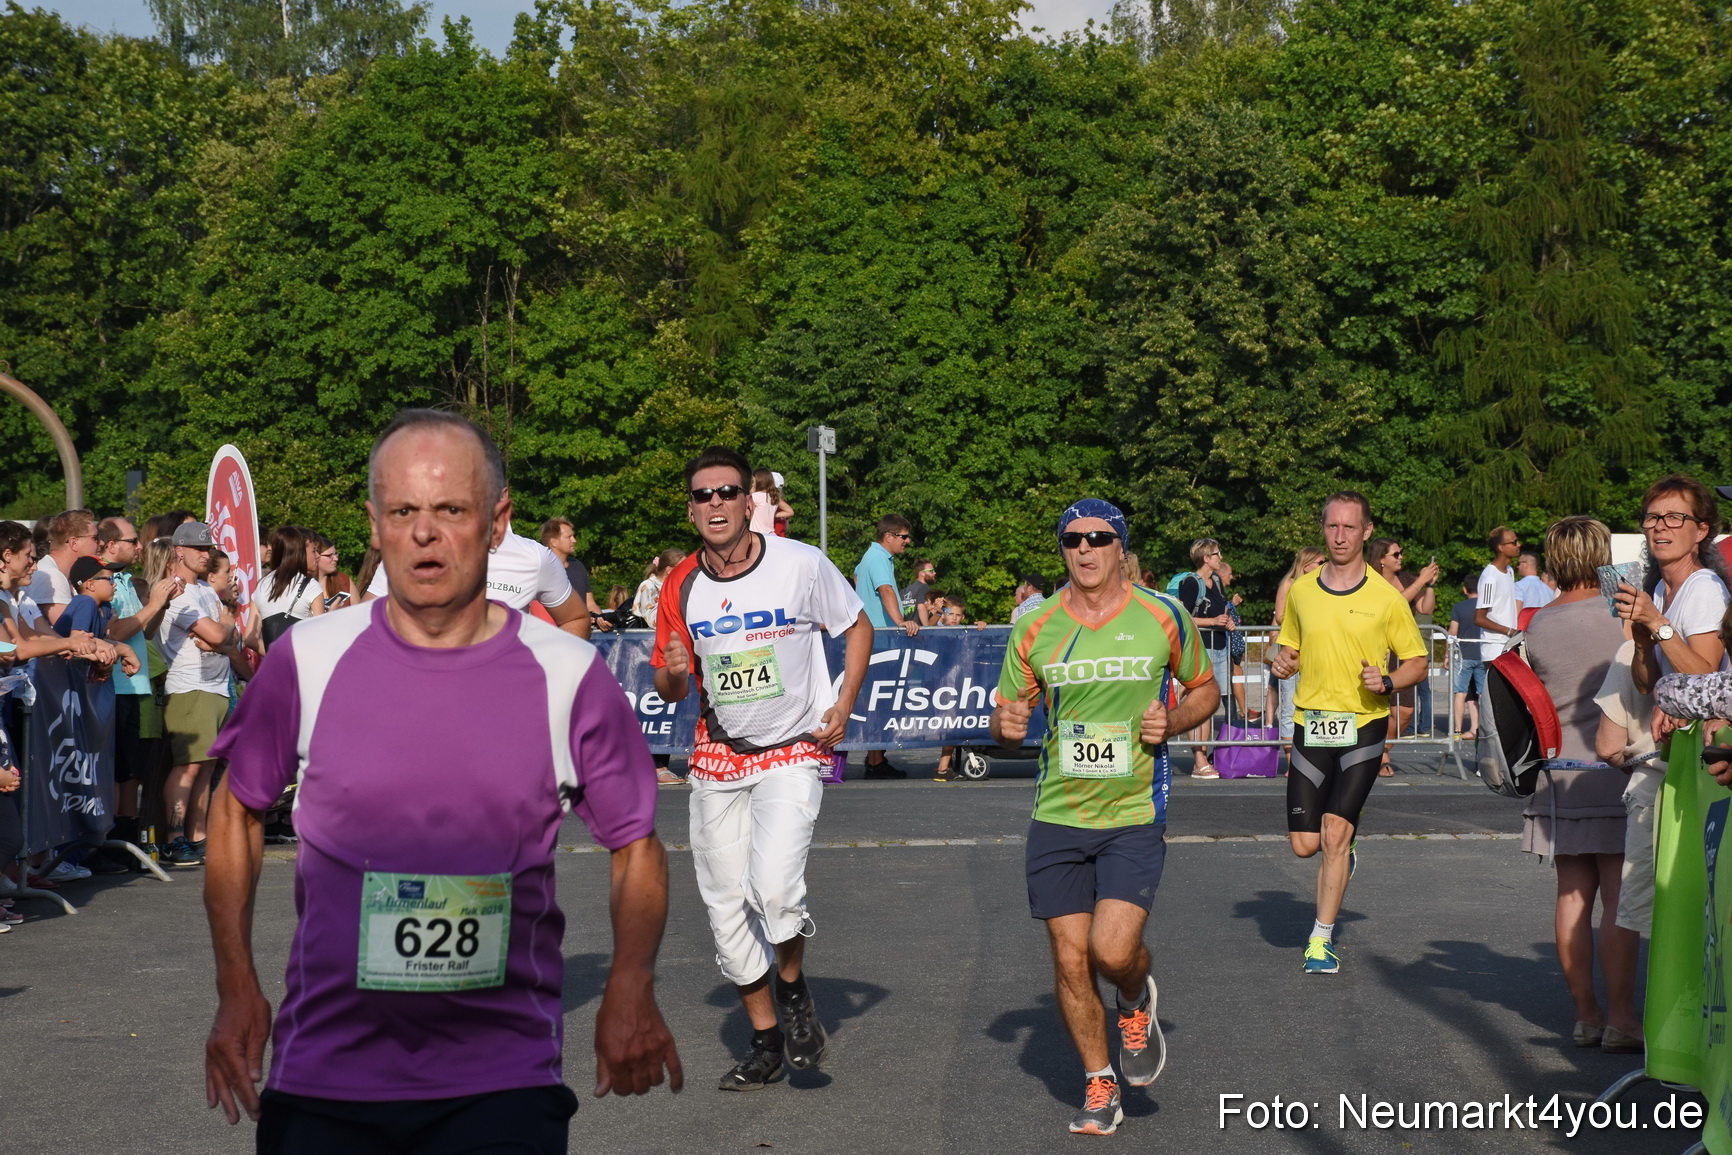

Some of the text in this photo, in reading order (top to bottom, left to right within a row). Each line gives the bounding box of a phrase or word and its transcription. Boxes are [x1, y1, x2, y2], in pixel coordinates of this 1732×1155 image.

[717, 665, 771, 691] 2074
[1042, 656, 1154, 688] BOCK
[1310, 720, 1349, 735] 2187
[1073, 742, 1115, 763] 304
[394, 917, 480, 958] 628
[405, 960, 470, 972] Frister Ralf
